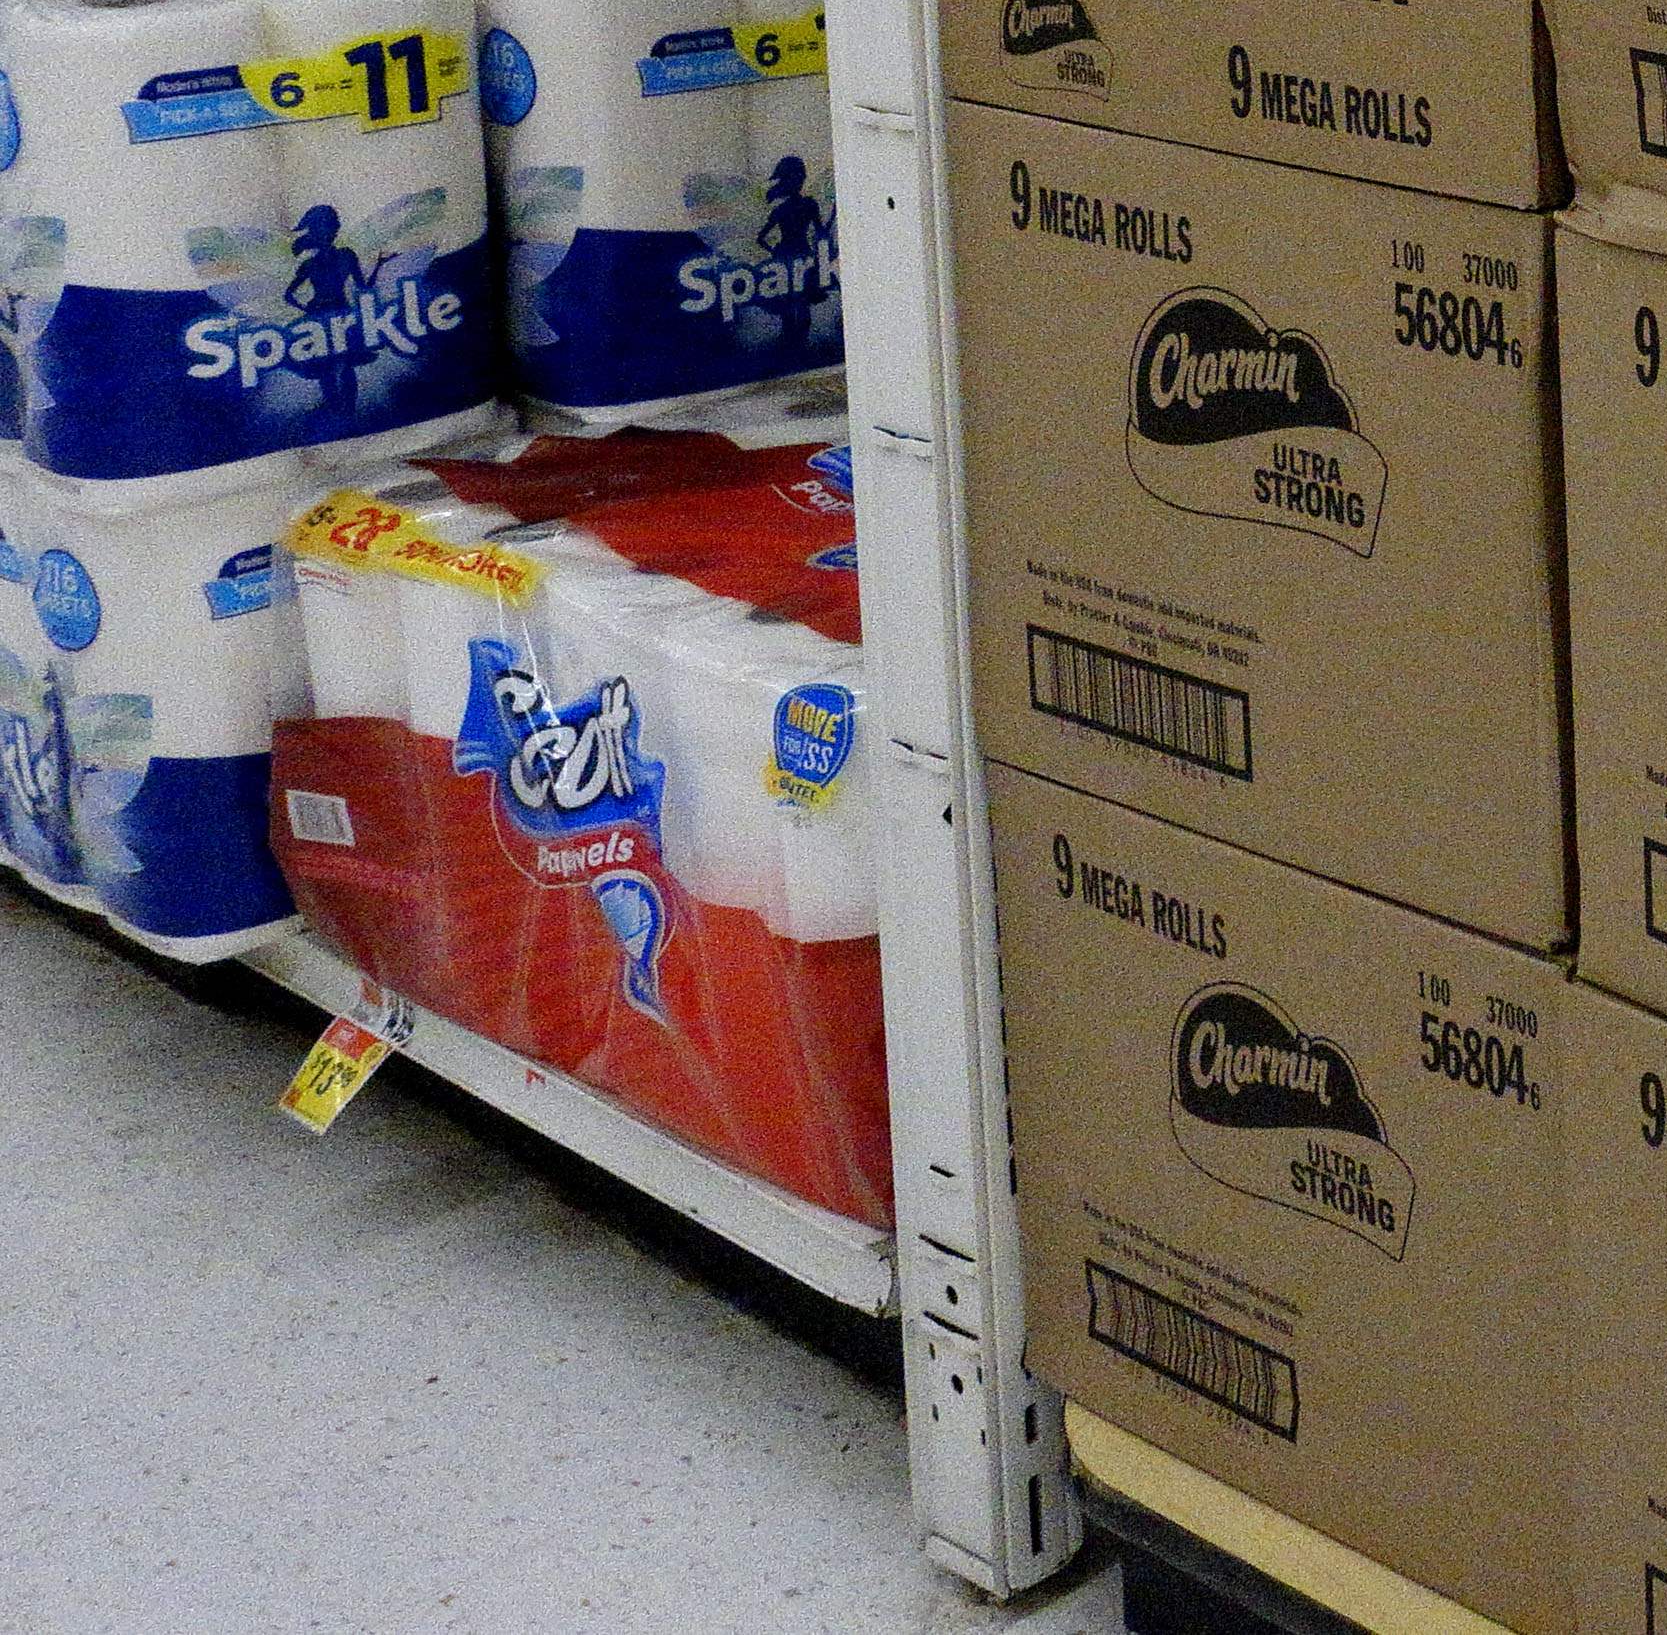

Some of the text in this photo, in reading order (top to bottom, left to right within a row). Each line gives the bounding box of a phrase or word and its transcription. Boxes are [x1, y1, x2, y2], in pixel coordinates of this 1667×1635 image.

[269, 71, 305, 109] 6
[346, 35, 428, 120] 11
[755, 33, 781, 66] 6
[1228, 44, 1433, 149] 9 MEGA ROLLS
[1010, 160, 1032, 232] 9
[186, 282, 463, 387] Sparkle
[1634, 306, 1661, 388] 9
[1253, 470, 1366, 529] STRONG
[1290, 1163, 1396, 1233] STRONG
